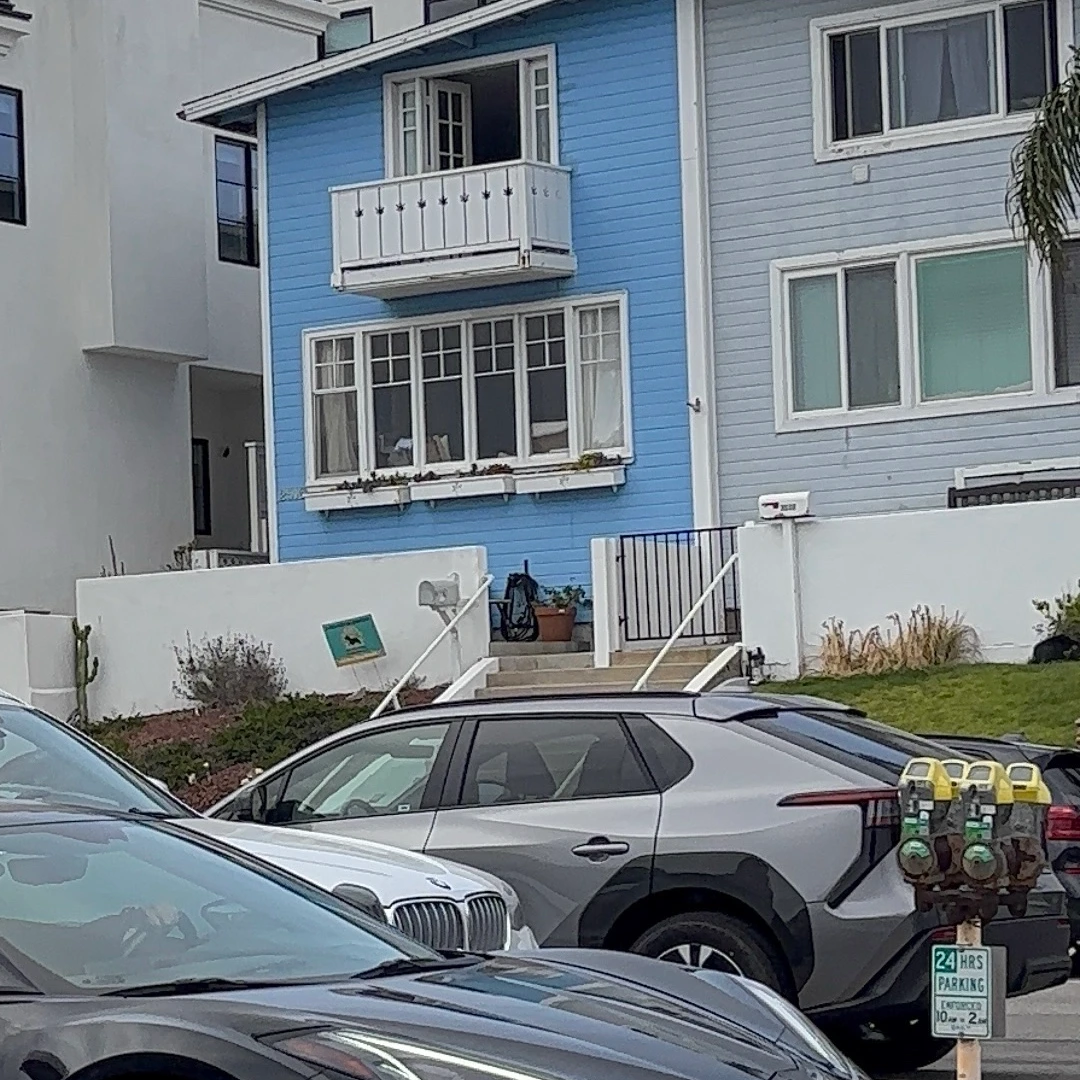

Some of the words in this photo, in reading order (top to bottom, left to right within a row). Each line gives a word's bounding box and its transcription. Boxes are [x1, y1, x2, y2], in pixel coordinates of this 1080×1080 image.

[935, 951, 956, 970] 24
[960, 955, 984, 970] HRS
[938, 976, 984, 992] PARKING
